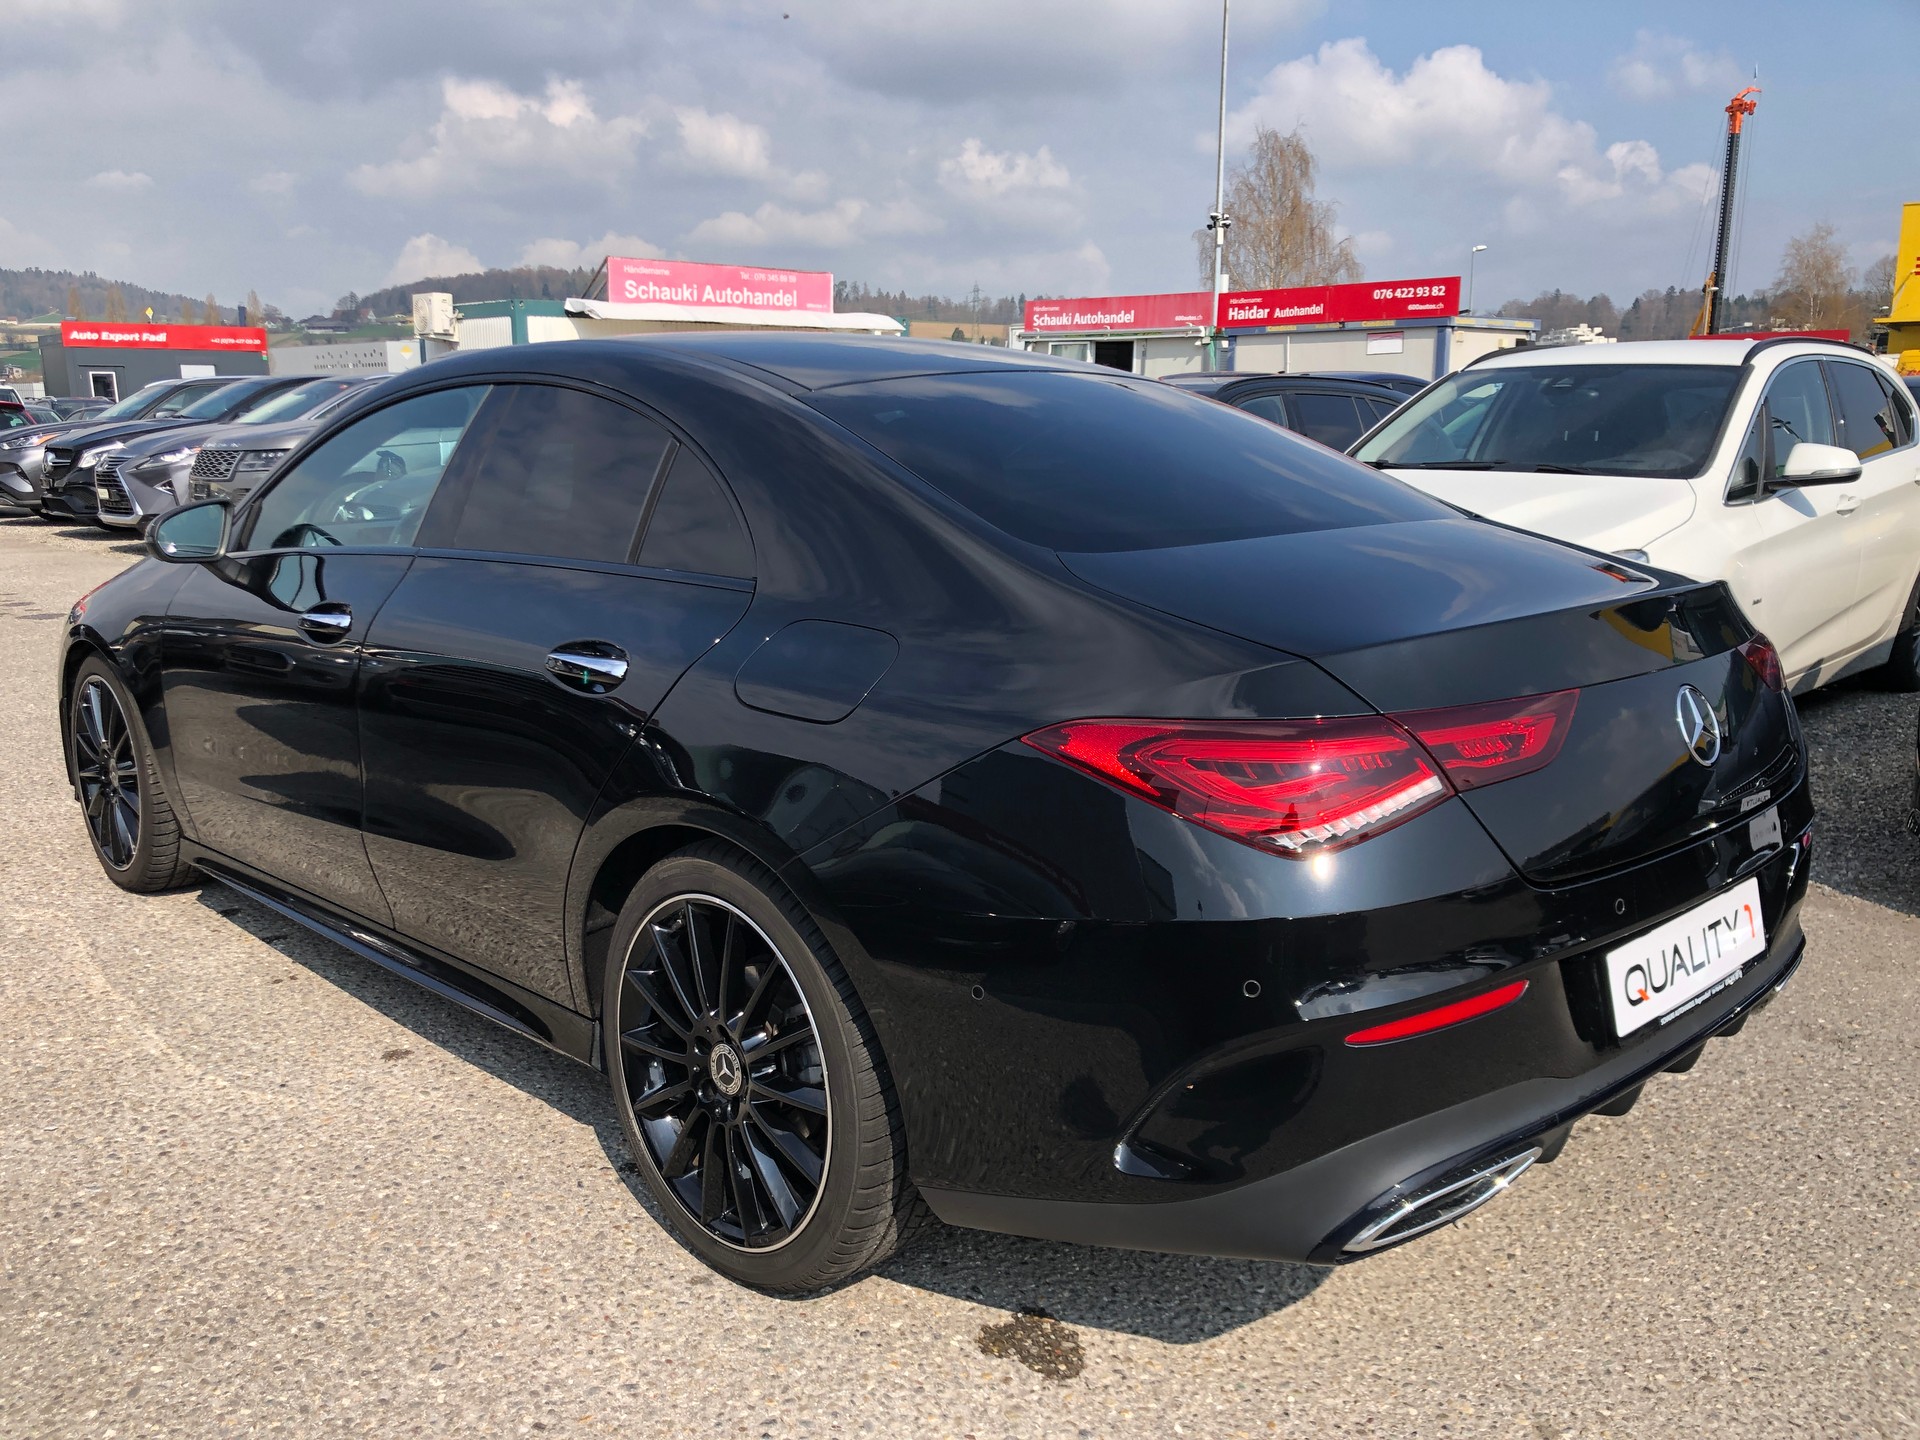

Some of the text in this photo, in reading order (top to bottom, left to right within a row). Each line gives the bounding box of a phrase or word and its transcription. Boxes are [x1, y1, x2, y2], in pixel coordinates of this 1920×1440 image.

[624, 279, 797, 307] Schauki Autohandel
[1373, 285, 1446, 300] 076 422 93 82
[1033, 310, 1135, 327] Schauki Autohandel
[1228, 303, 1324, 321] Haidar Autohandel
[70, 330, 167, 343] Auto Export Fadi
